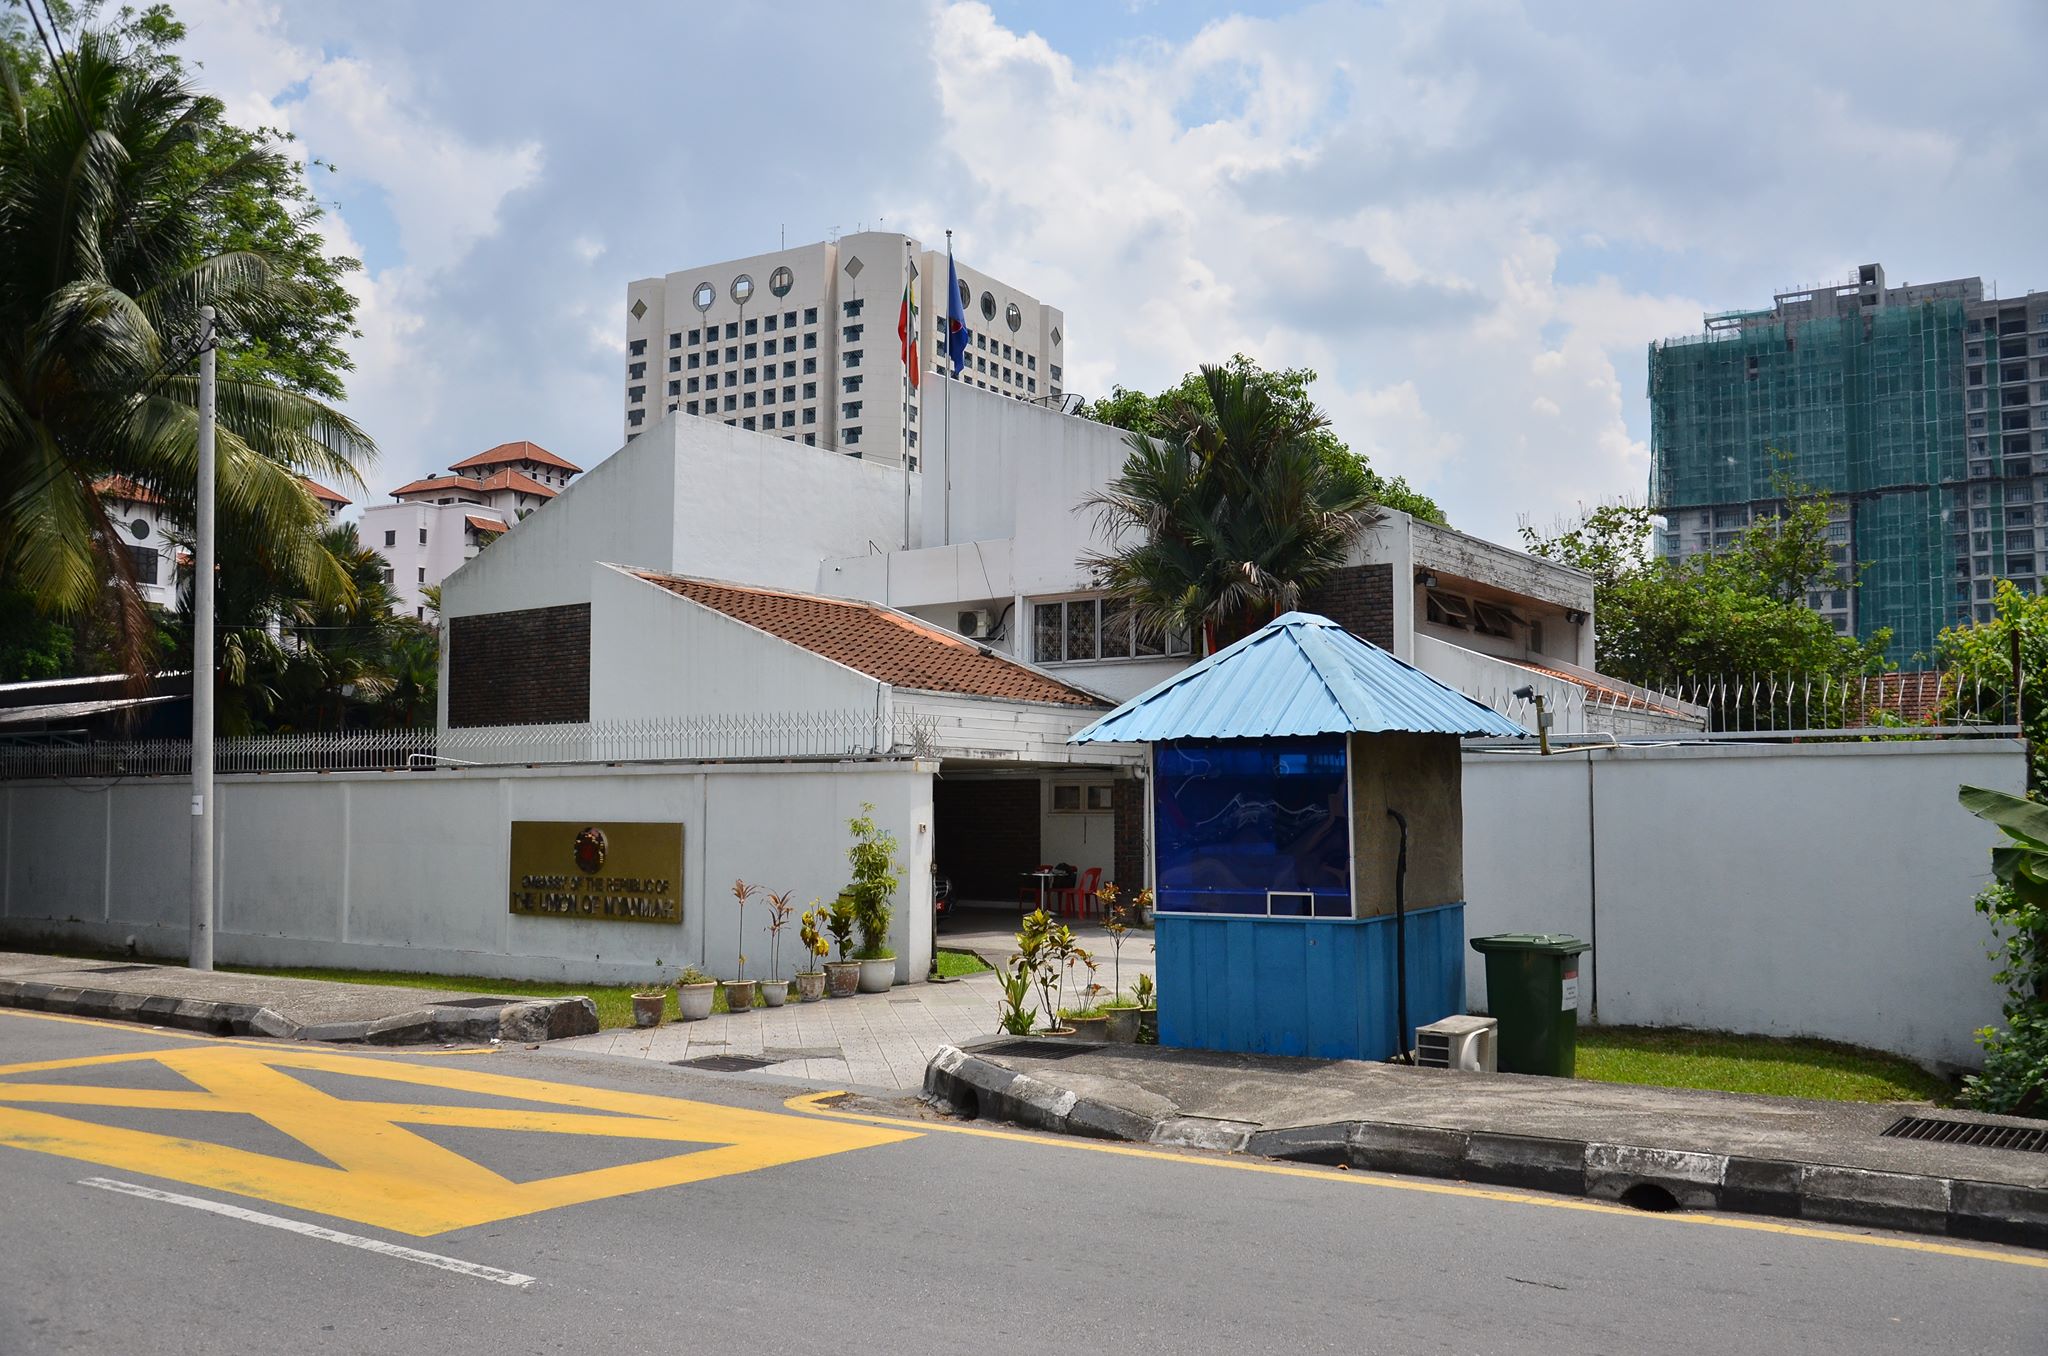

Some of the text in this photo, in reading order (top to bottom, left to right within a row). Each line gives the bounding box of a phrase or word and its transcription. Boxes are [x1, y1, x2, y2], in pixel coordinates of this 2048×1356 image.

[570, 876, 582, 891] OF
[586, 877, 604, 892] THE
[607, 878, 654, 893] REPUBLIC
[655, 879, 669, 894] OF
[512, 892, 674, 918] THE UNION OF MYANMAR
